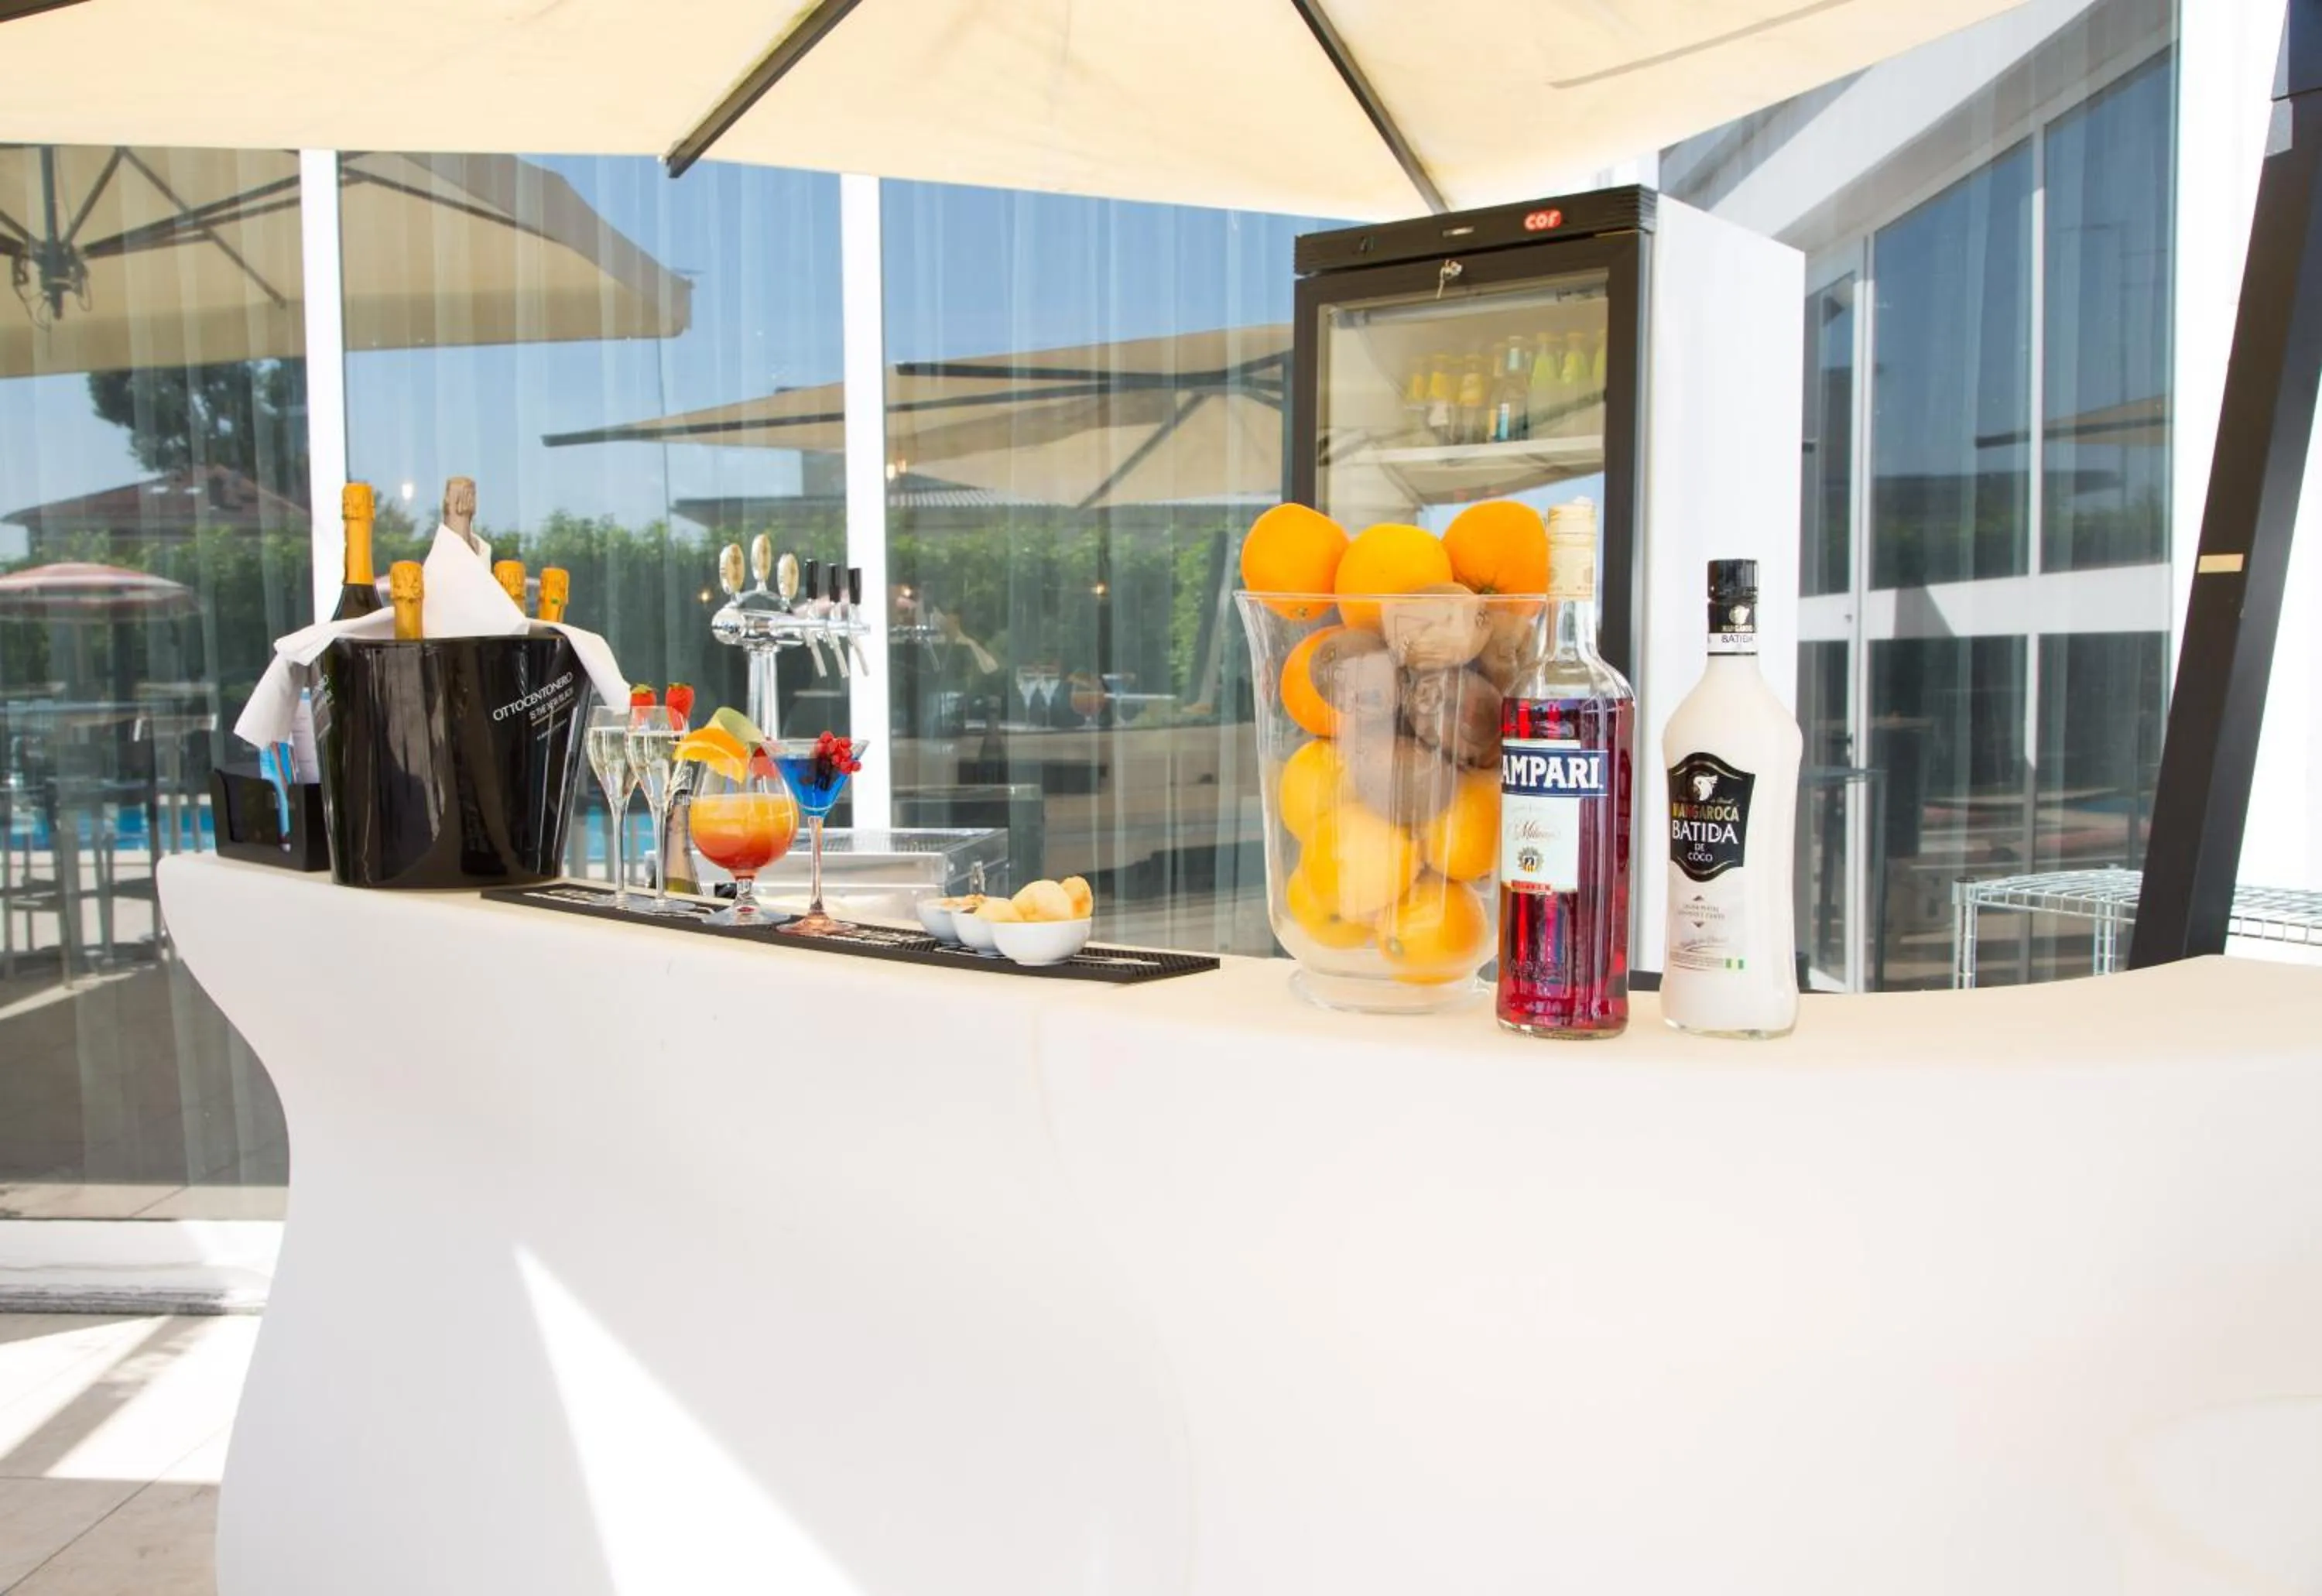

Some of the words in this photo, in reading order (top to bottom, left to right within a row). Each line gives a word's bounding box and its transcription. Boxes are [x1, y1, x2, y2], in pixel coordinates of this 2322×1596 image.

[493, 672, 573, 721] OTTOCENTONERO
[1502, 755, 1601, 789] AMPARI
[1673, 820, 1739, 844] BATIDA
